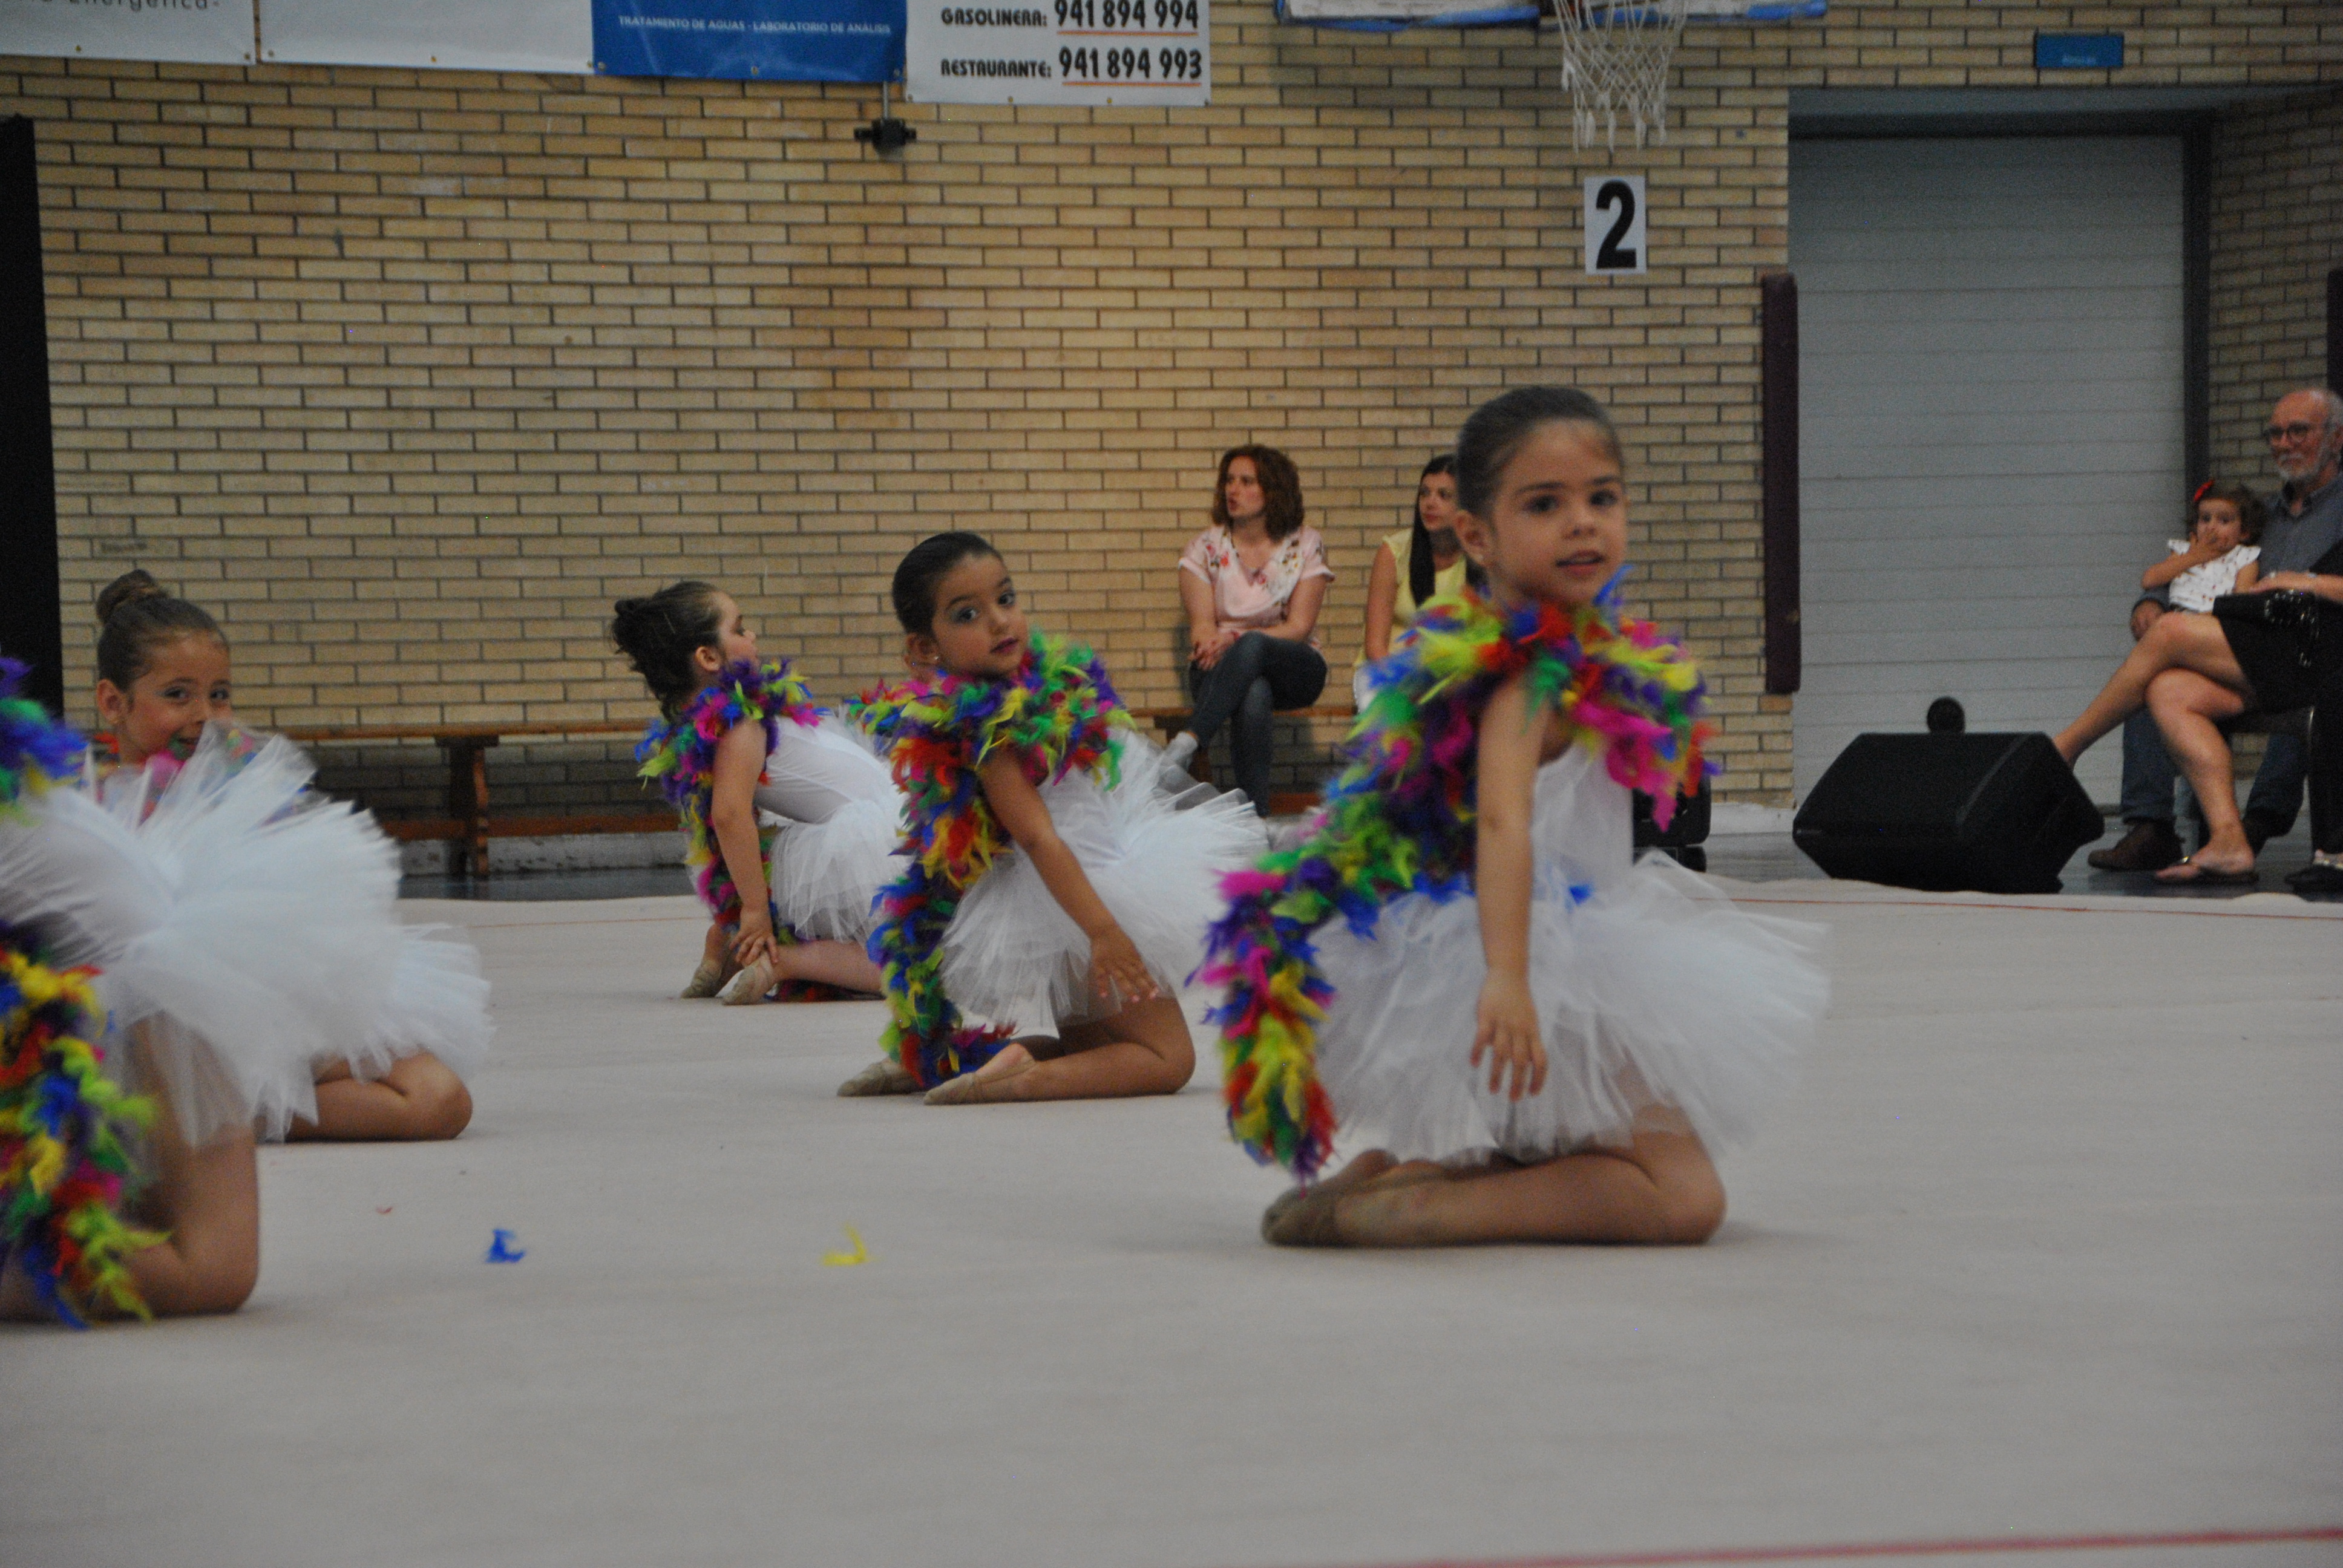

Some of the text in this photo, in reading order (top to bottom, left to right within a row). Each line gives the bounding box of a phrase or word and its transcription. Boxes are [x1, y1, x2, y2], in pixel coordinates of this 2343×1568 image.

[618, 15, 689, 28] TRATAMIENTO
[692, 18, 706, 30] DE
[707, 19, 745, 31] AGUAS
[753, 21, 828, 33] LABORATORIO
[831, 22, 844, 33] DE
[941, 0, 1199, 28] GASOLINERA: 941 894 994
[941, 46, 1202, 79] RESTAURANTE: 941 894 993
[1596, 180, 1637, 269] 2
